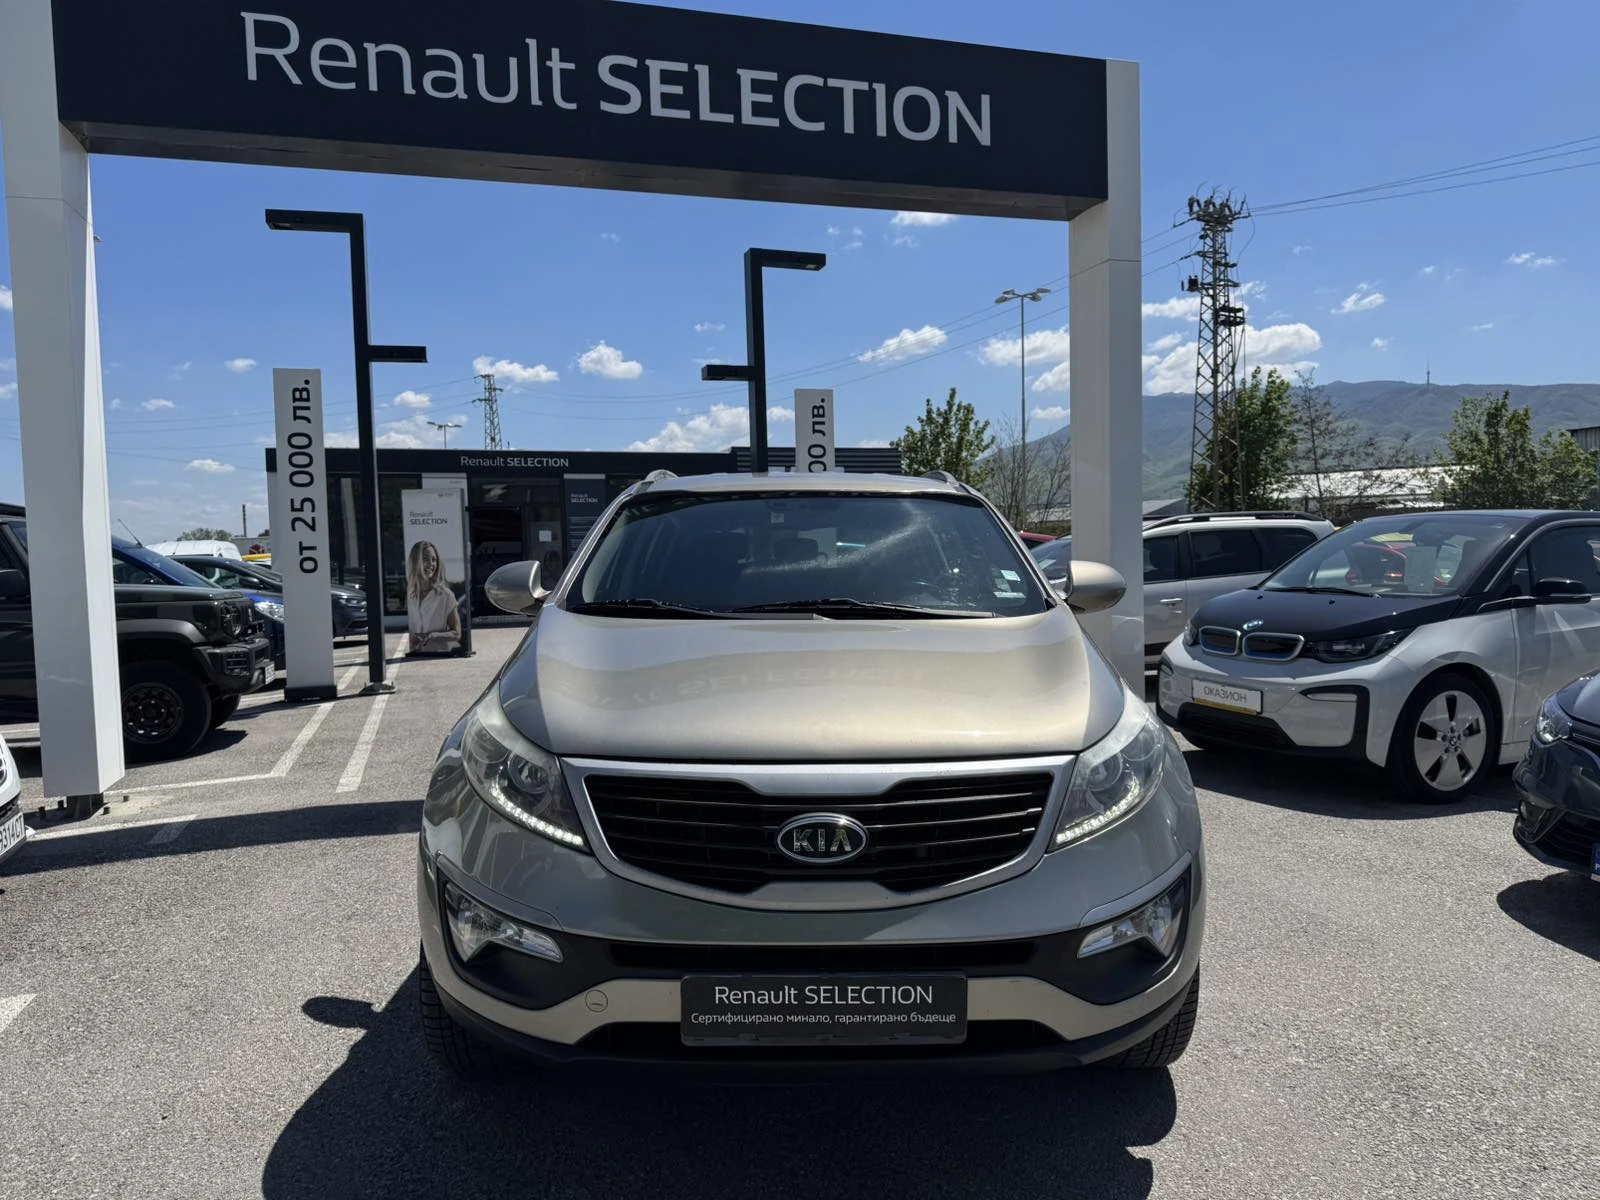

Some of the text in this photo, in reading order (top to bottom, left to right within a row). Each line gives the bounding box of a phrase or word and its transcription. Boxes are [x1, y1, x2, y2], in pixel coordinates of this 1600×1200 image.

[240, 11, 991, 147] Renault SELECTION
[811, 398, 826, 436] лв.
[460, 456, 569, 467] Renault SELECTION
[287, 379, 319, 574] от 25 000 лв.
[409, 518, 448, 526] SELECTION
[1203, 686, 1248, 703] ОКАЗИОН
[793, 828, 853, 852] KIA
[714, 985, 933, 1005] Renault SELECTION
[691, 1011, 957, 1025] Сертифицирано минало, гарантирано бъдеще
